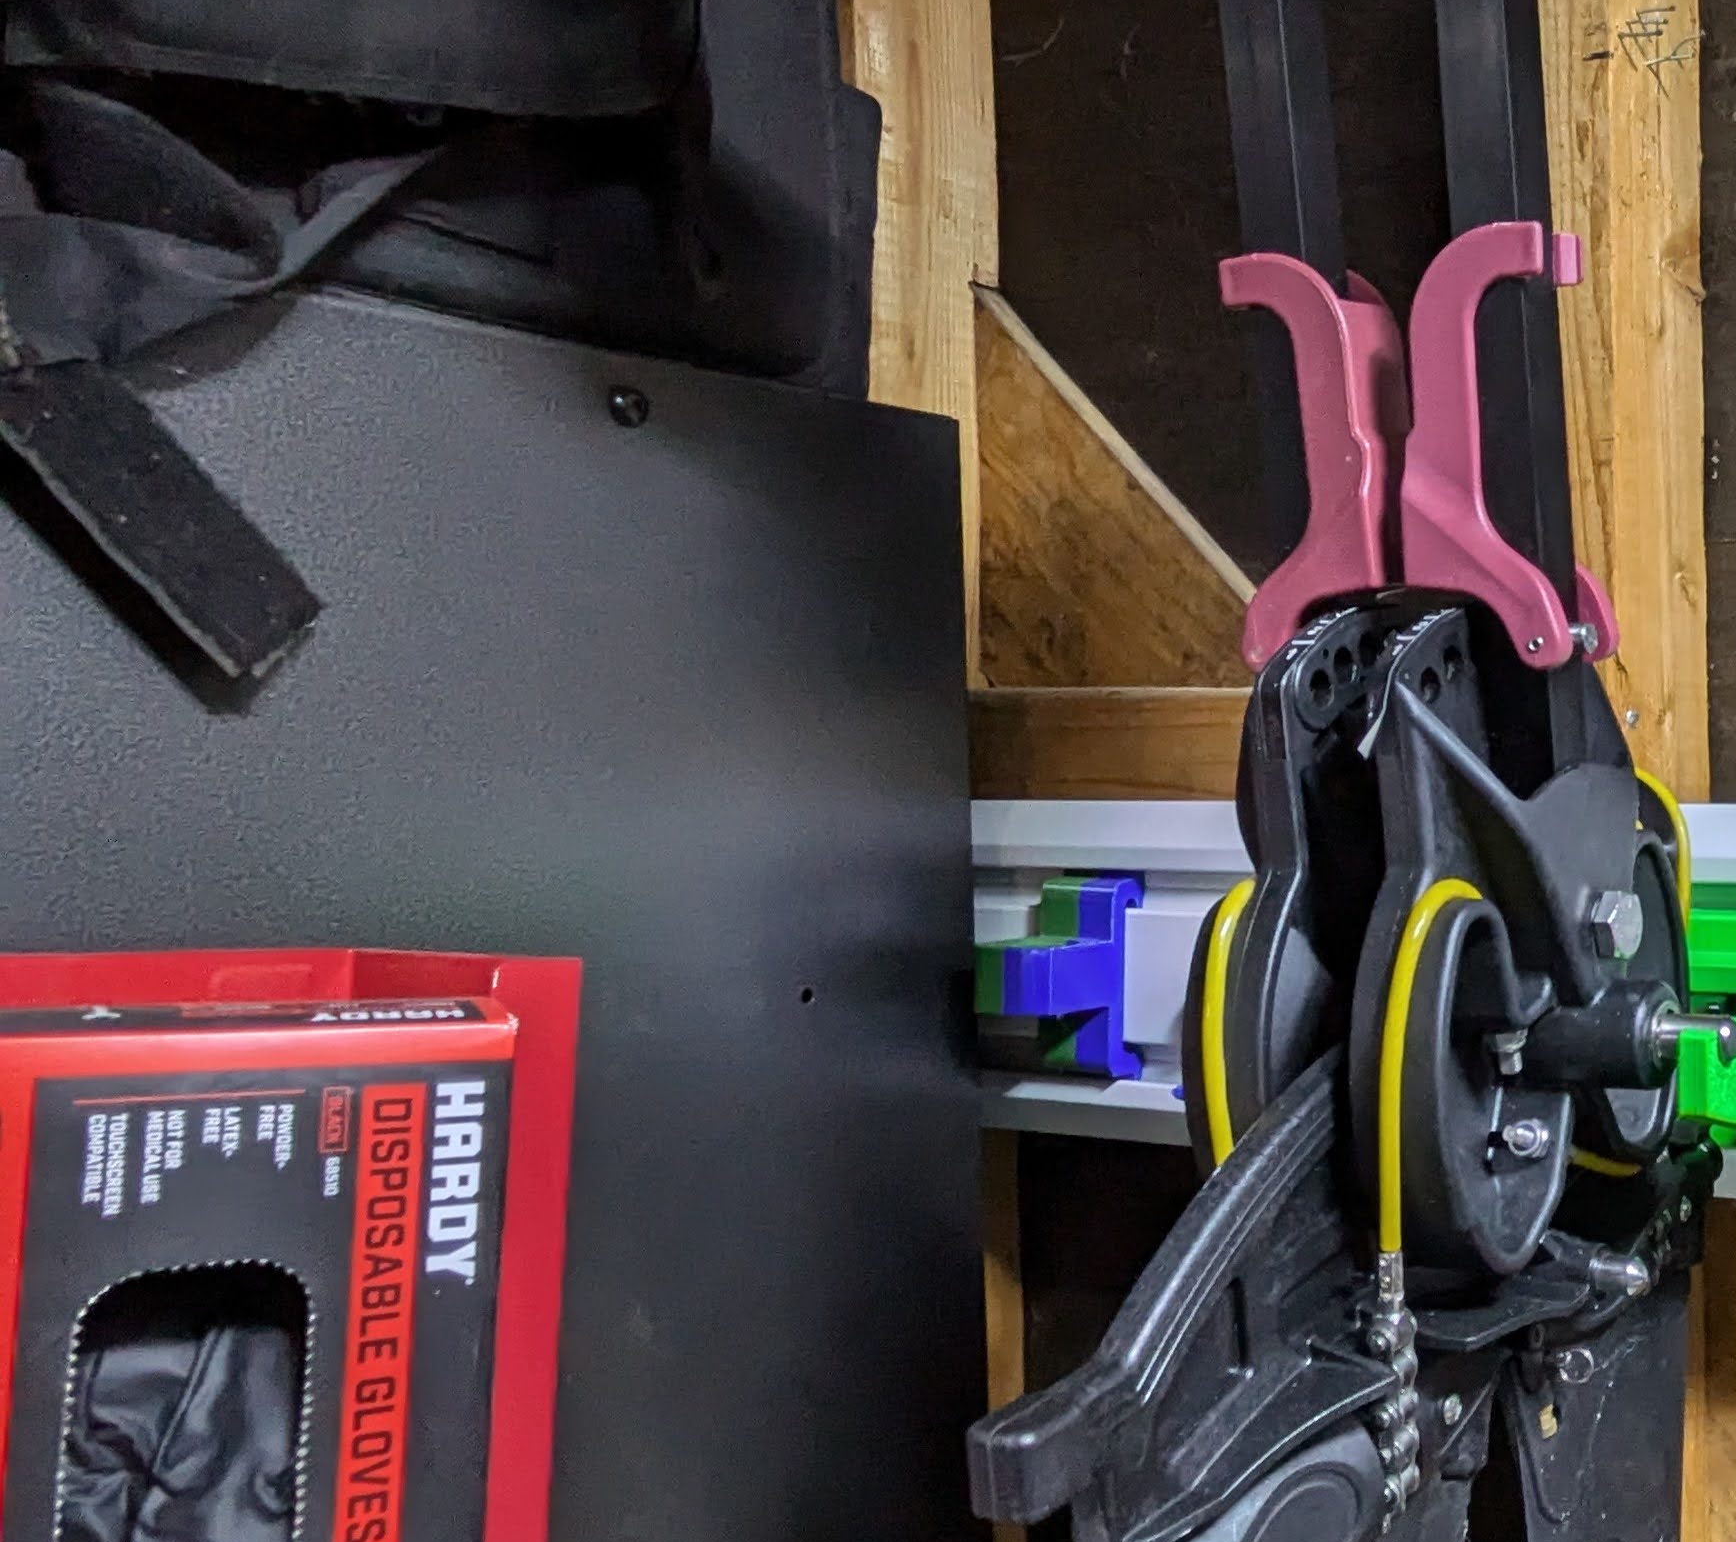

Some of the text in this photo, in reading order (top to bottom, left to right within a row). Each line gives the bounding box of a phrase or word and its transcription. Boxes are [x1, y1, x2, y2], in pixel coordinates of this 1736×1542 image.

[82, 1113, 107, 1204] COMPATIBLE
[140, 1110, 166, 1204] MEDICAL USE
[164, 1109, 187, 1170] NOT FOR
[201, 1107, 222, 1145] FREE
[221, 1106, 243, 1159] LATEX-
[256, 1104, 277, 1141] FREE
[273, 1103, 295, 1171] POWDER-
[102, 1112, 128, 1217] TOUCHSCREEN
[424, 1081, 486, 1283] HARDY
[355, 1096, 413, 1365] DISPOSABLE
